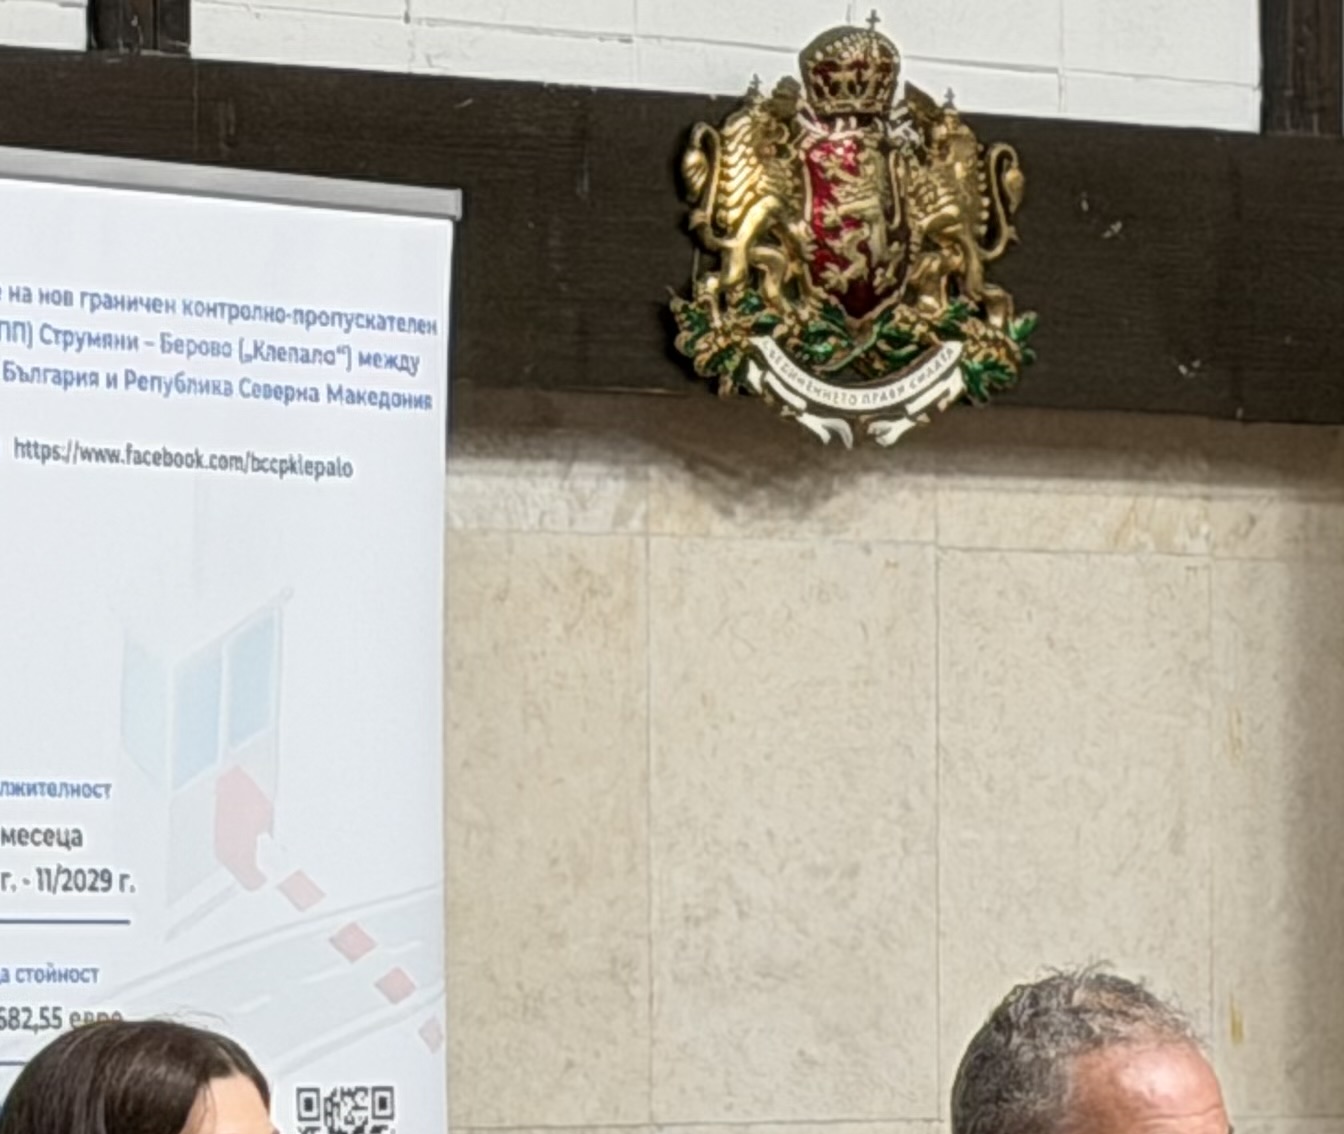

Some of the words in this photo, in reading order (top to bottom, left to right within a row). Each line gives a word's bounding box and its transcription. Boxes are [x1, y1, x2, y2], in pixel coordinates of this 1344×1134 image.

[8, 284, 33, 304] на
[38, 287, 74, 307] нов
[80, 291, 176, 315] граничен
[182, 298, 438, 335] контролно-пропускателен
[39, 322, 138, 352] Струмяни
[159, 332, 232, 359] Берово
[358, 350, 420, 377] между
[3, 360, 99, 390] България
[106, 373, 118, 389] и
[124, 369, 233, 398] Република
[238, 377, 320, 406] Северна
[326, 383, 433, 411] Македония
[0, 825, 83, 850] месеца
[0, 871, 17, 893] г.
[36, 863, 113, 894] 11/2029
[119, 872, 136, 893] г.
[15, 962, 100, 984] стойност
